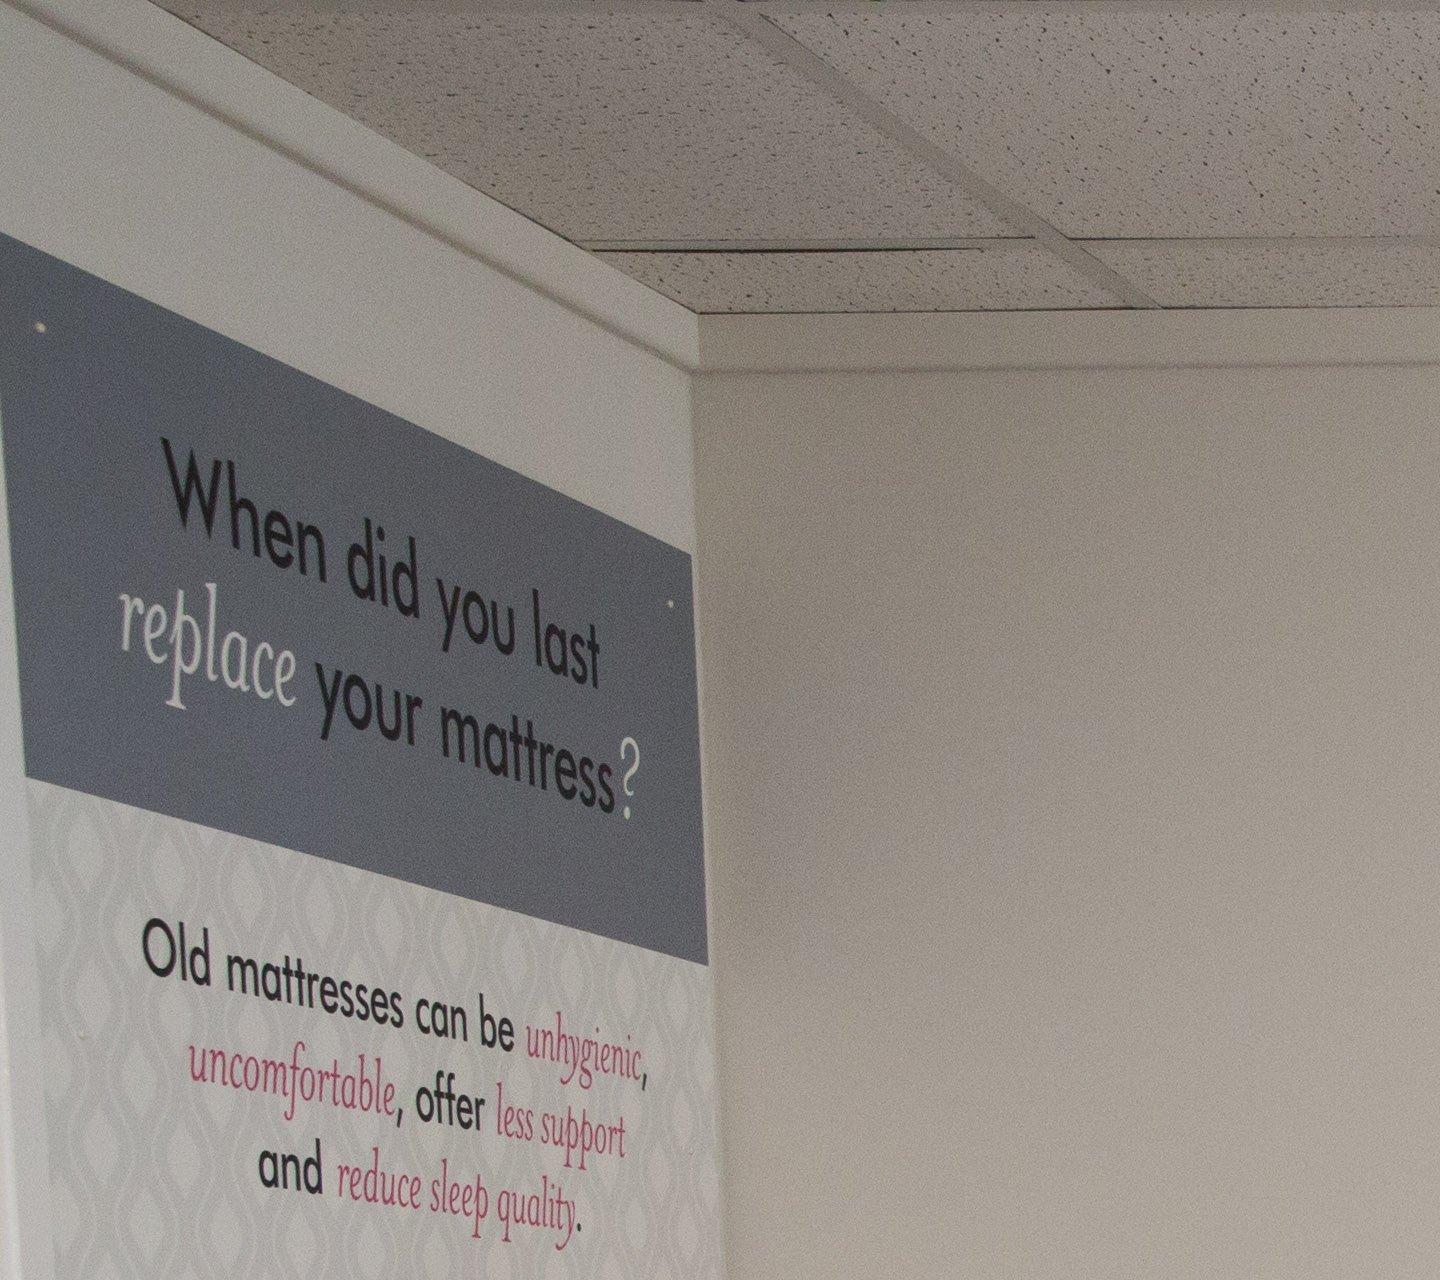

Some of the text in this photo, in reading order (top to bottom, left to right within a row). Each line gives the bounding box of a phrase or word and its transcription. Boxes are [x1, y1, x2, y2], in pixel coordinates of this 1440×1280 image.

[161, 436, 601, 690] When did you last
[119, 582, 641, 821] replace your mattress?
[141, 917, 649, 1092] Old mattresses can be unhygienic,
[188, 1040, 627, 1171] uncomfortable, offer less support
[258, 1138, 584, 1252] and reduce sleep quality.
